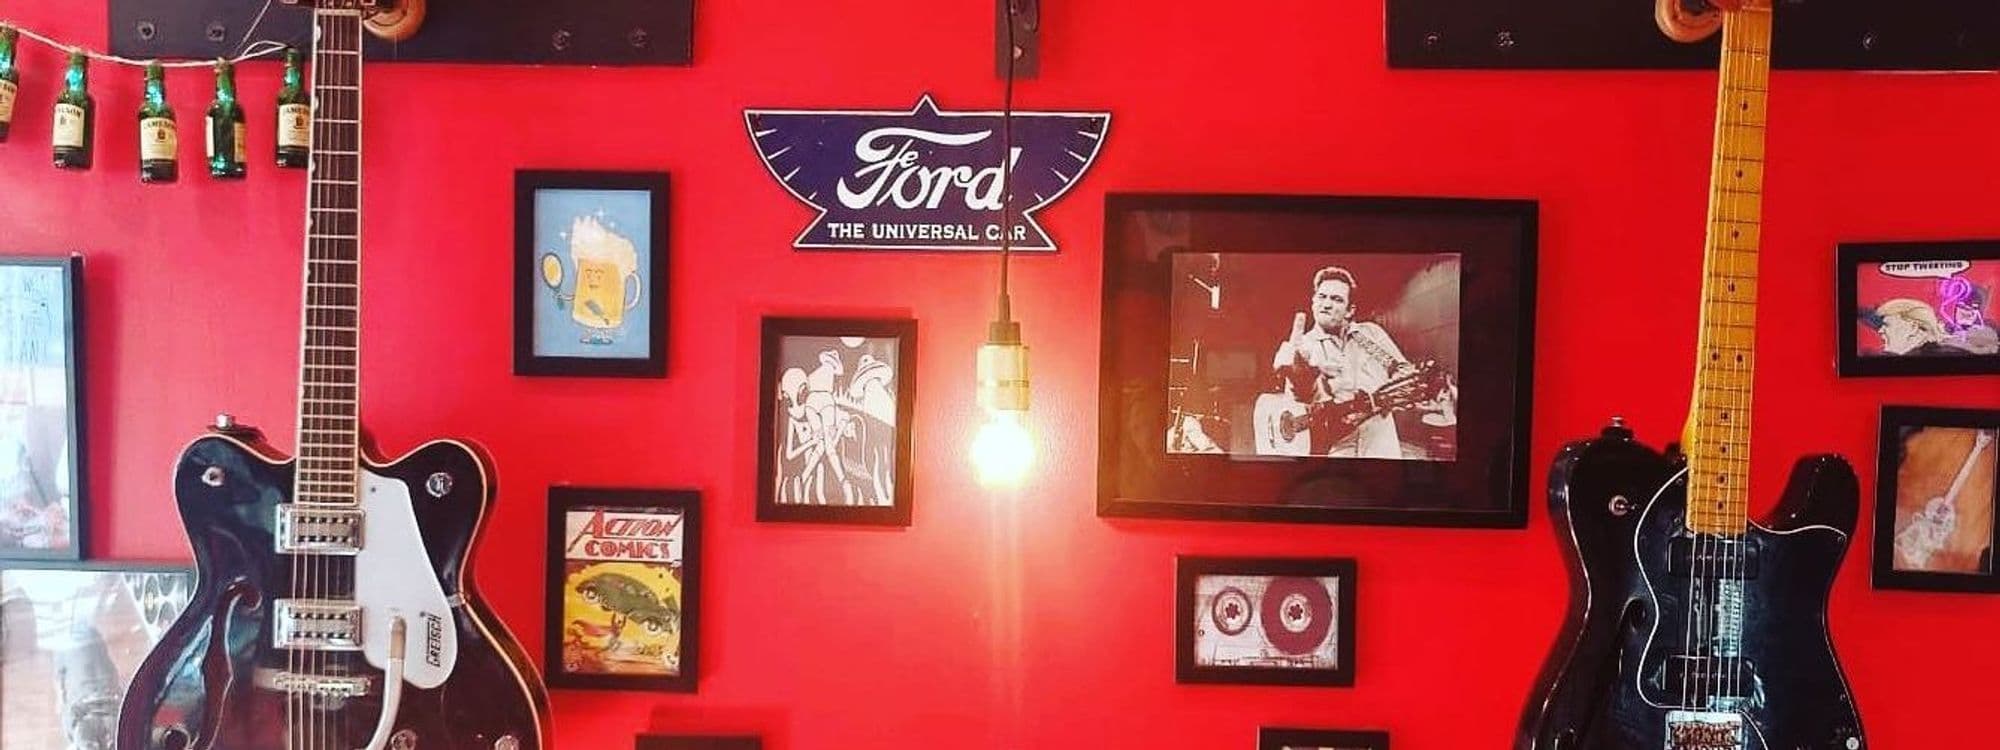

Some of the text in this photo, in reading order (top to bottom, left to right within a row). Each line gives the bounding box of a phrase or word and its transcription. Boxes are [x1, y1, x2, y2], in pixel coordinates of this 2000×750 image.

[836, 127, 1023, 211] Ford
[827, 222, 865, 239] THE
[871, 223, 980, 241] UNIVERSAL
[1885, 263, 1911, 272] STOP
[584, 540, 671, 560] COMICS
[426, 612, 442, 668] GRETSCH
